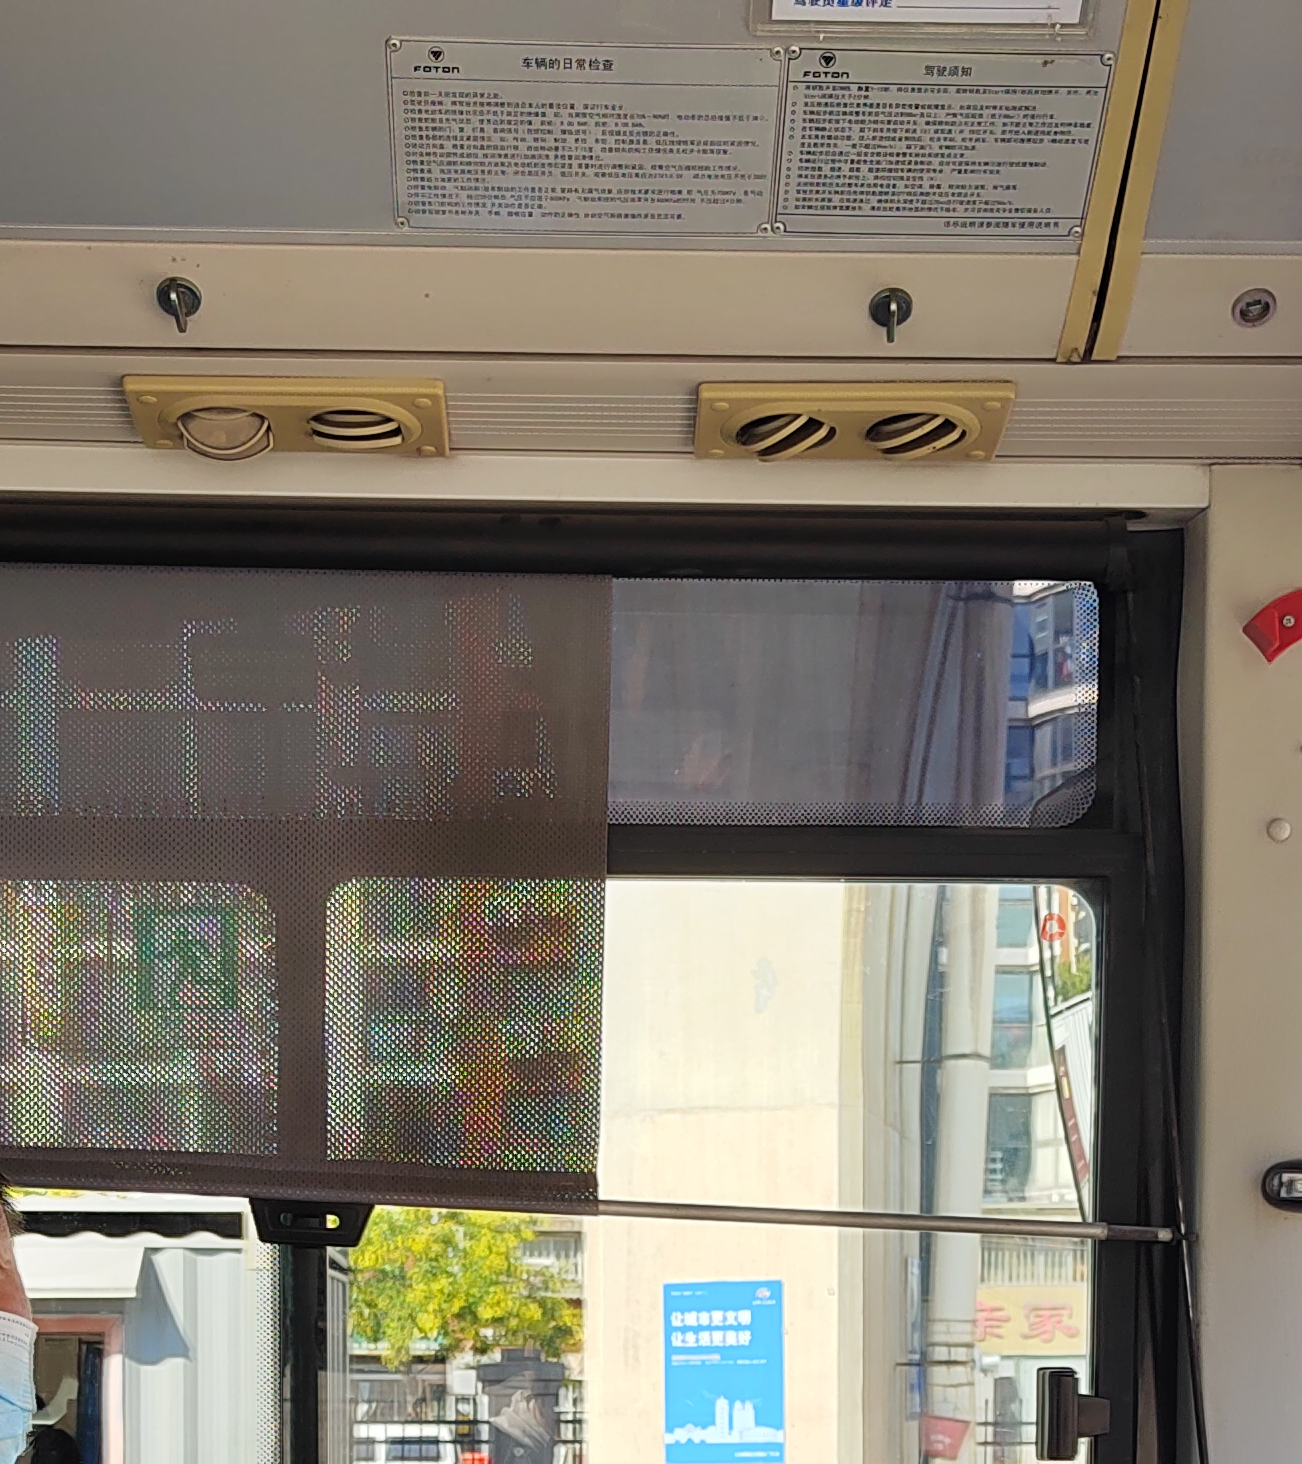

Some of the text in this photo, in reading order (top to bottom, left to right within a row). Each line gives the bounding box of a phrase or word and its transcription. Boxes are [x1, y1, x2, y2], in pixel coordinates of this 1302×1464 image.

[413, 65, 460, 74] FOTON
[521, 56, 614, 72] 车辆的日常检查
[923, 64, 973, 78] 驾驶须知
